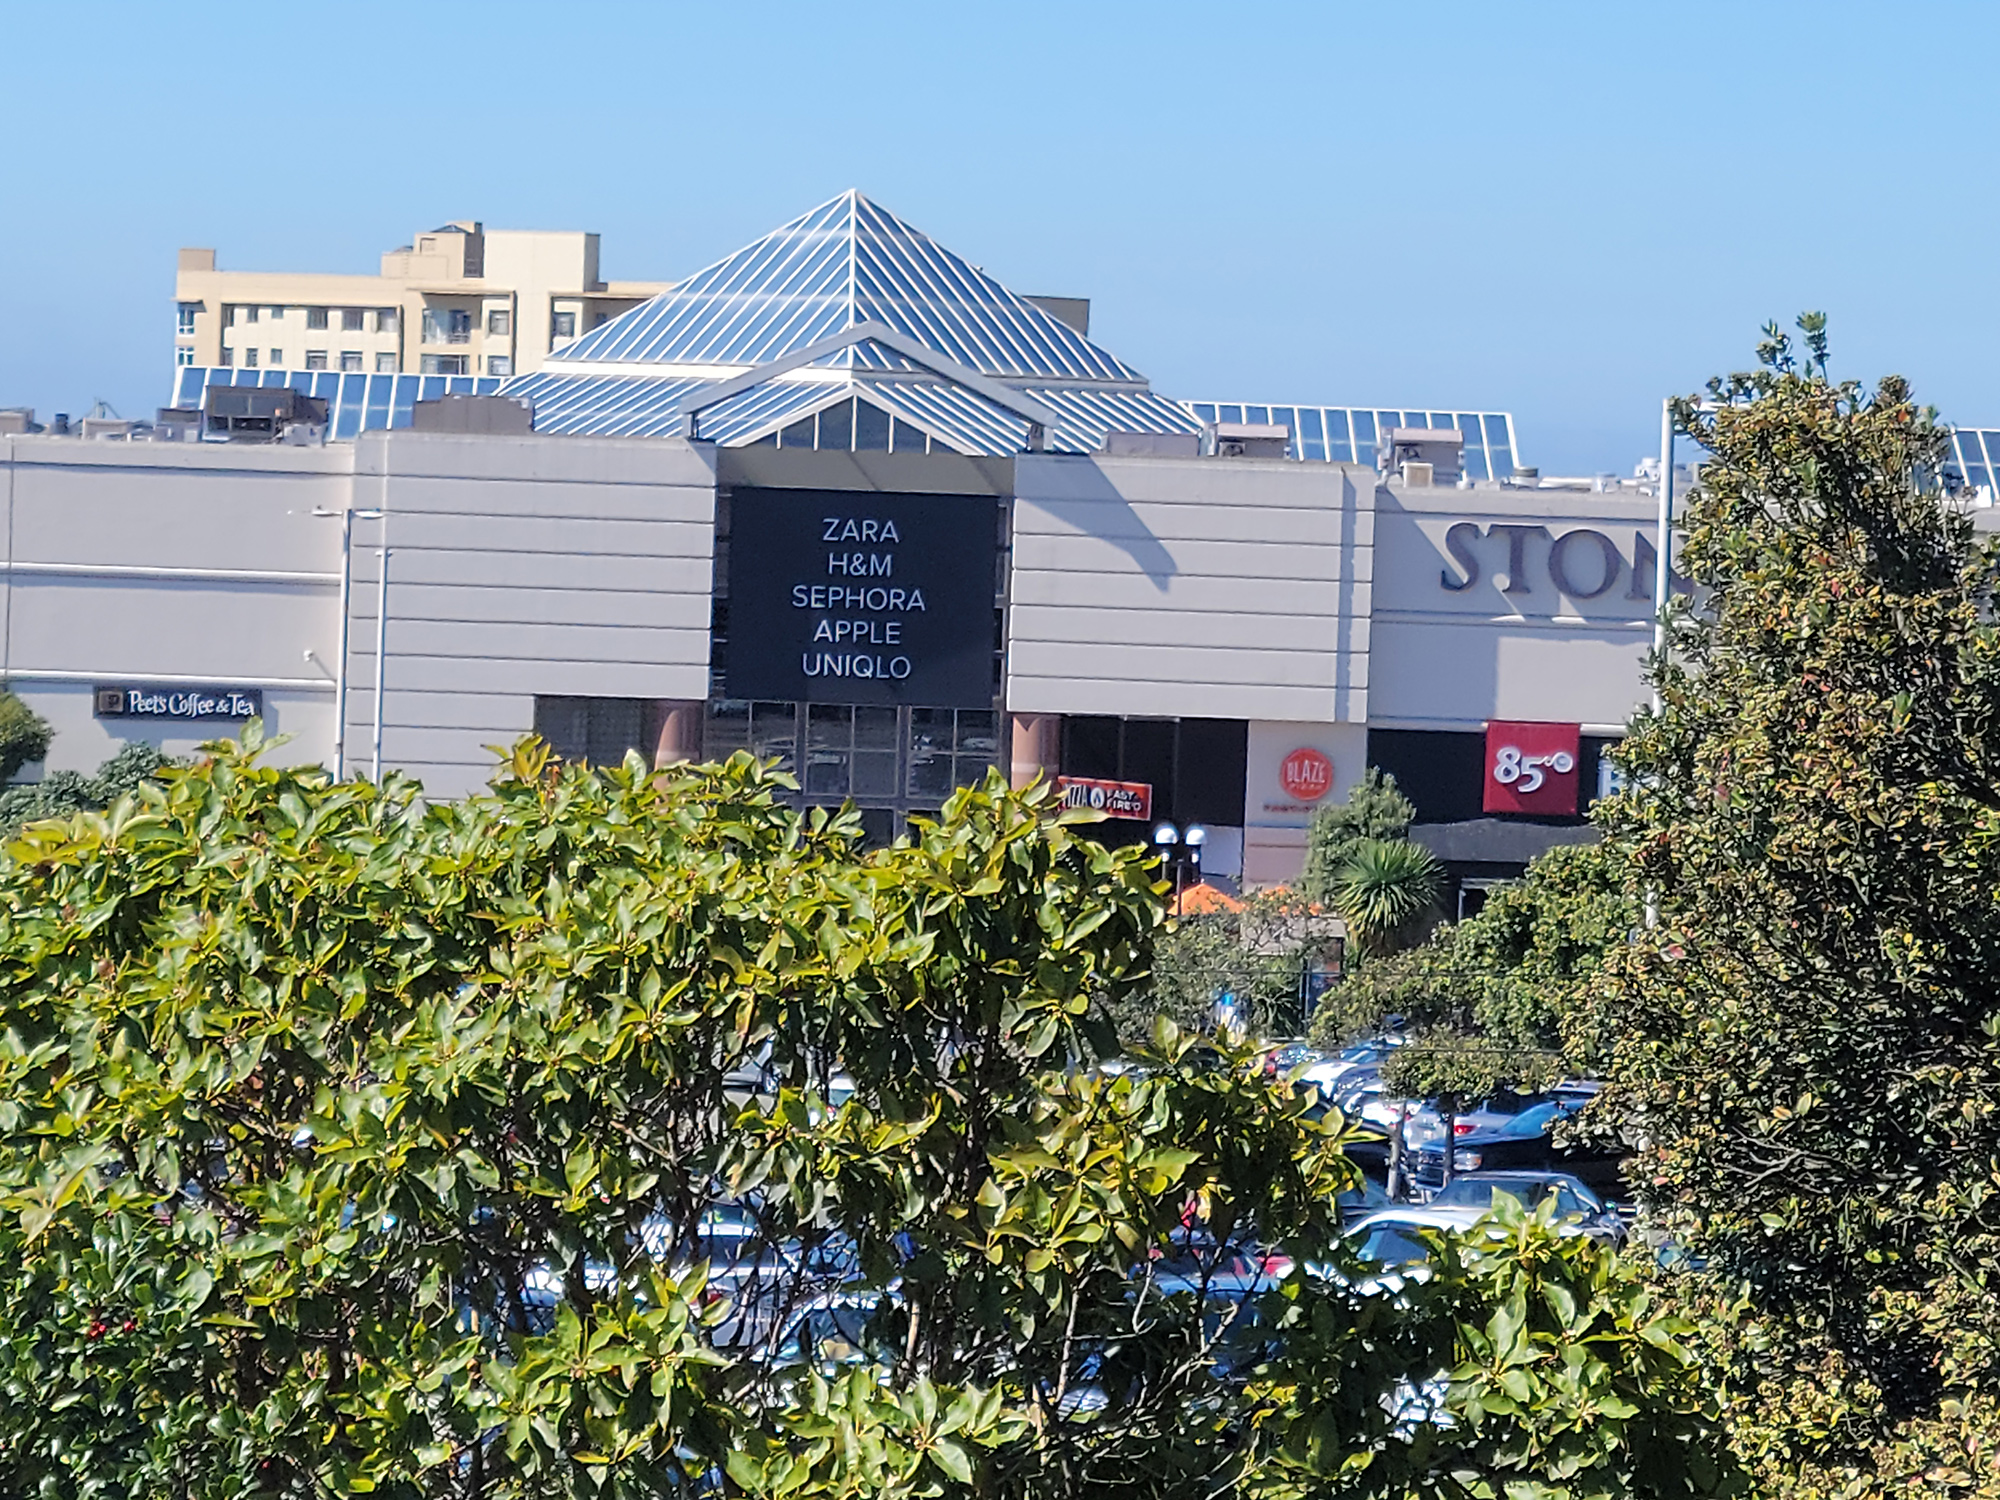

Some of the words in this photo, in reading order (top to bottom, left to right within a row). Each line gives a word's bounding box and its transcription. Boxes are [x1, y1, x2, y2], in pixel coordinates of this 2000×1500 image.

[822, 518, 900, 543] ZARA
[828, 553, 892, 578] H&M
[791, 585, 926, 611] SEPHORA
[813, 619, 901, 645] APPLE
[803, 653, 912, 680] UNIQLO
[127, 690, 167, 715] Peet's
[169, 693, 214, 718] Coffee
[216, 699, 229, 714] &
[227, 693, 255, 716] Tea
[1287, 758, 1327, 783] BLAZE
